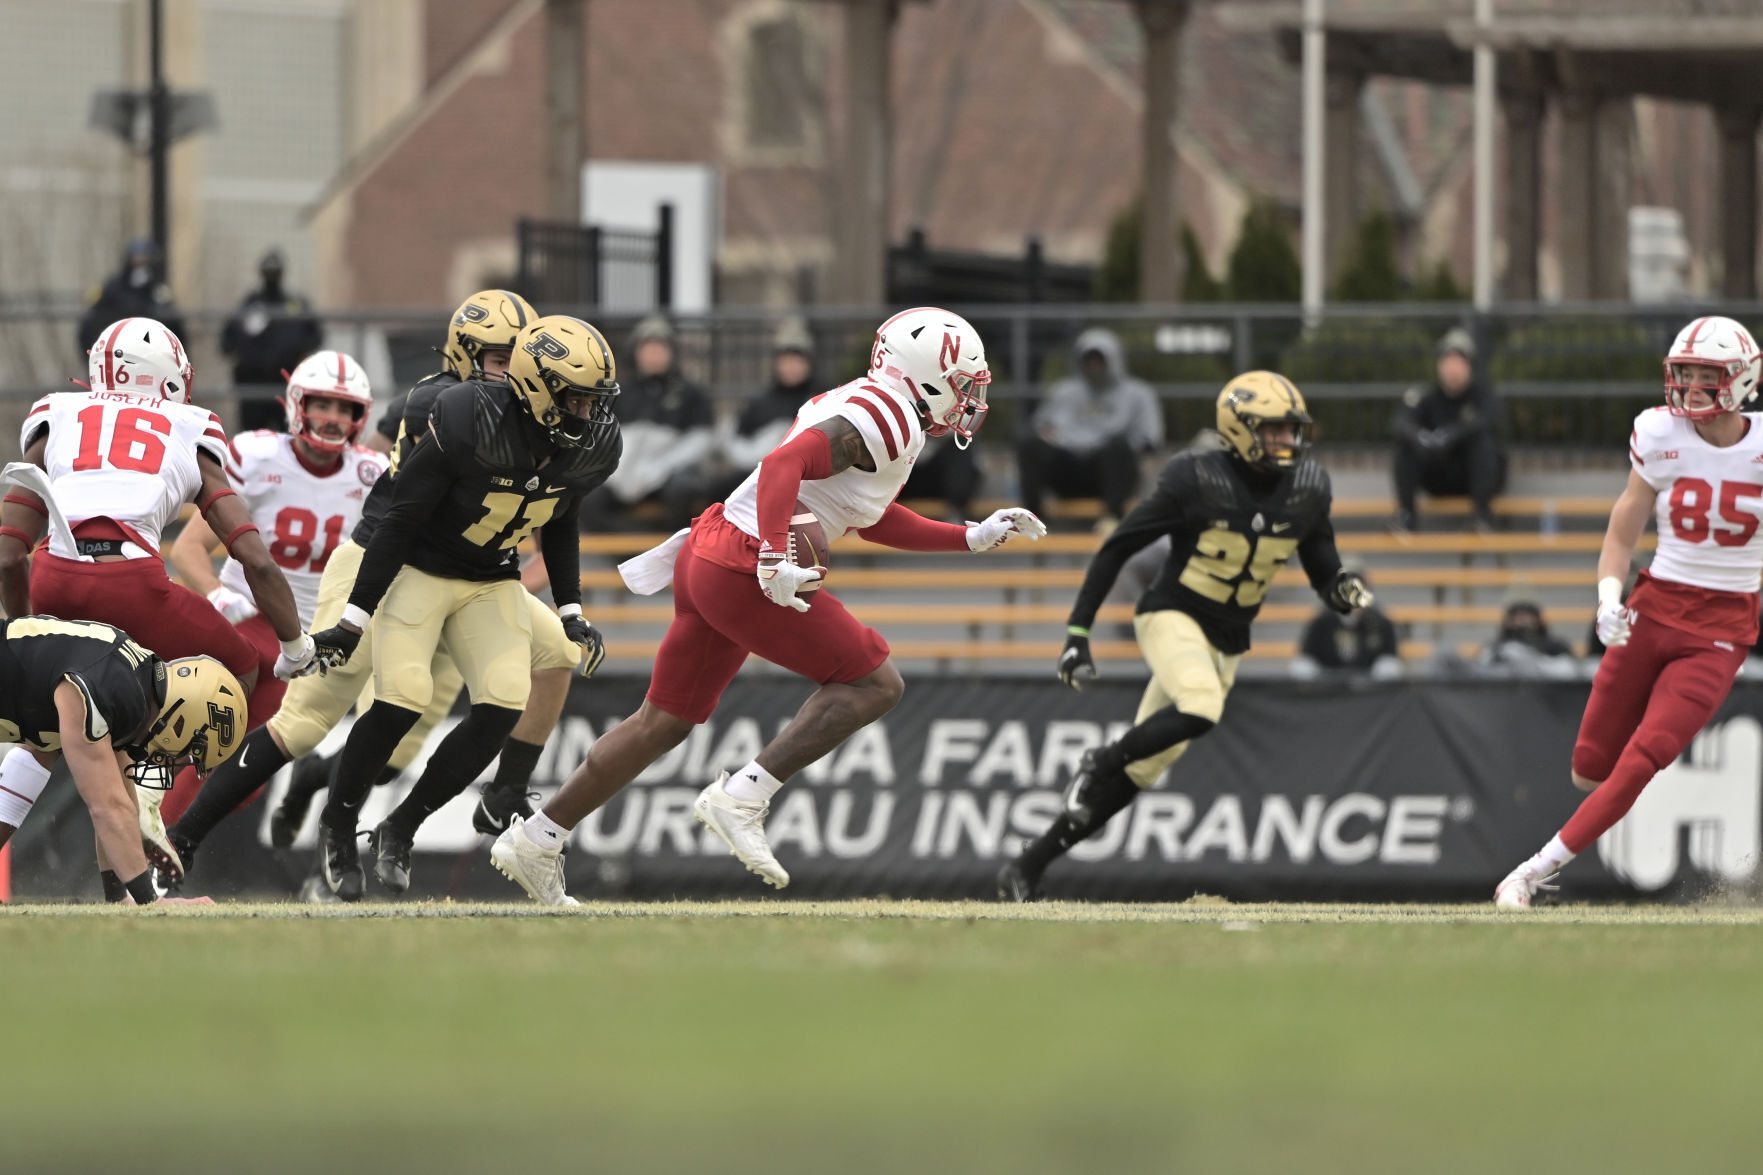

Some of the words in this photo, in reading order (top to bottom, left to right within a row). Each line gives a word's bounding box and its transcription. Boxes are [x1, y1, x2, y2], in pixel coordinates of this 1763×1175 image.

[522, 332, 569, 360] P
[940, 332, 960, 372] N
[1734, 330, 1752, 354] N
[72, 404, 172, 475] 16
[270, 506, 345, 574] 81
[461, 491, 560, 550] 11
[1669, 477, 1763, 547] 85
[1178, 528, 1299, 608] 25
[207, 701, 235, 748] P
